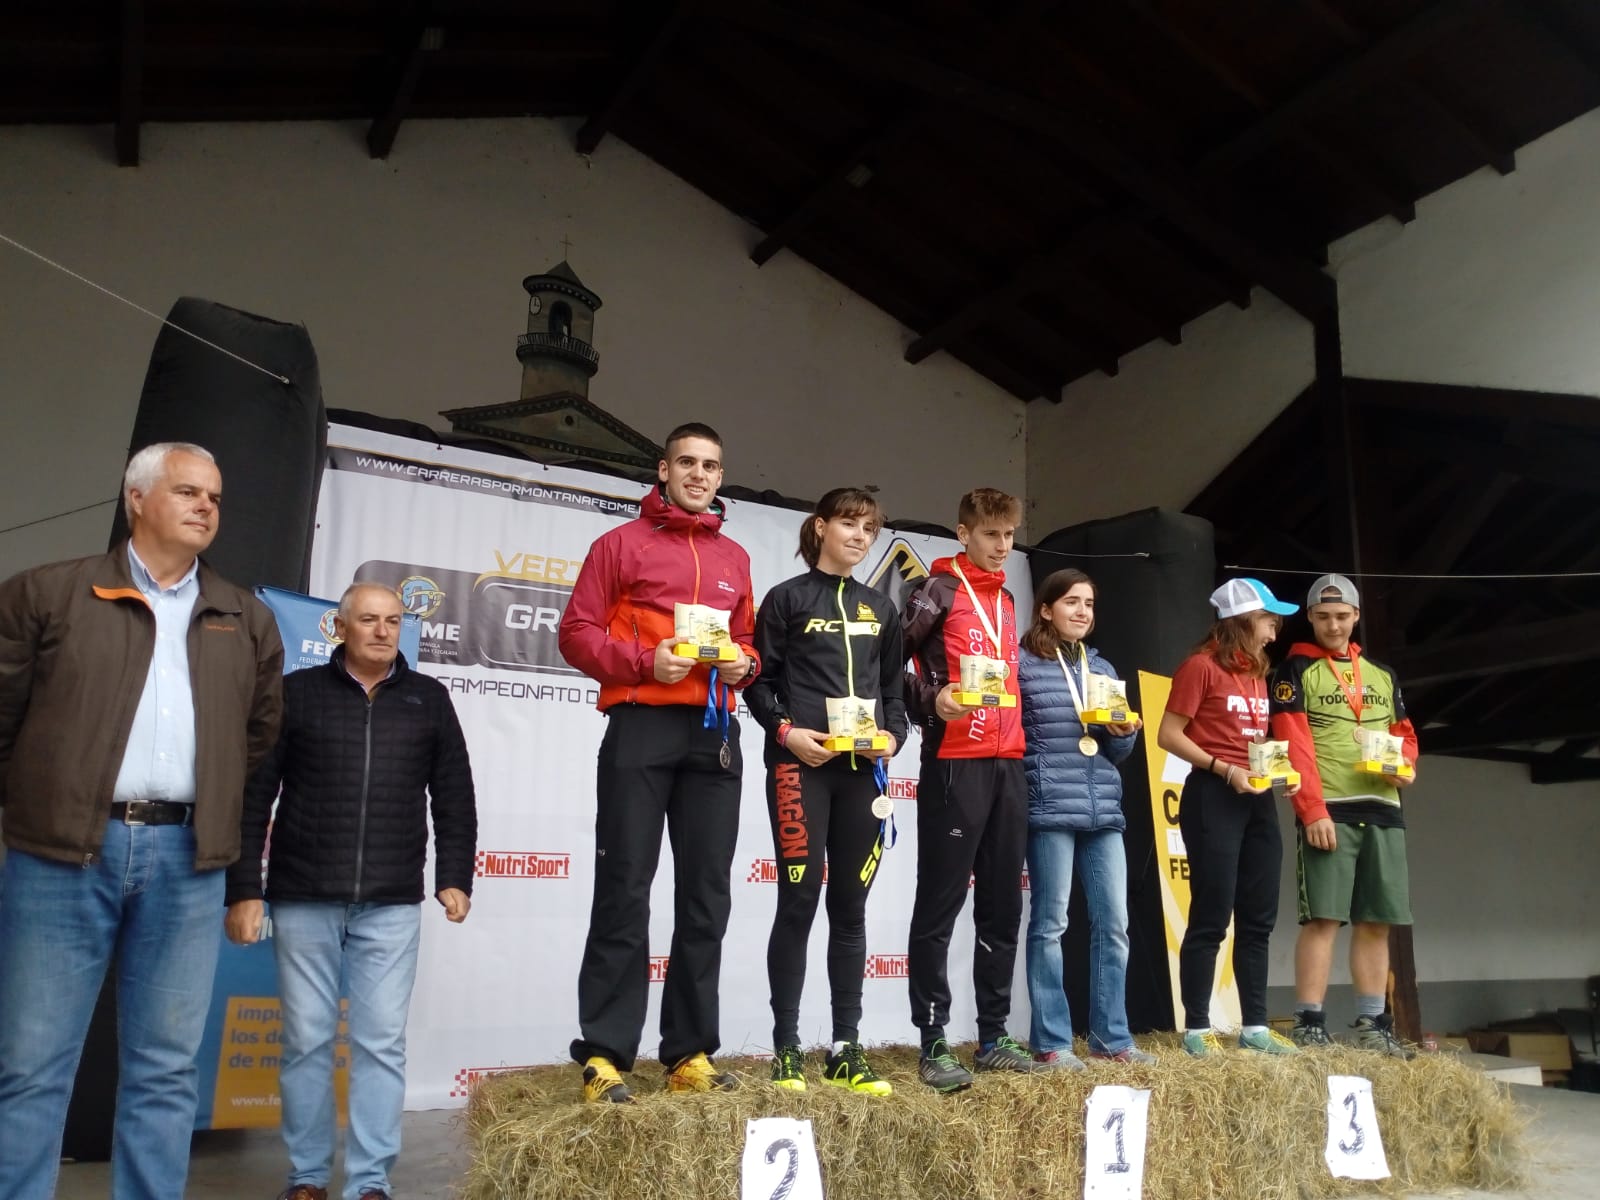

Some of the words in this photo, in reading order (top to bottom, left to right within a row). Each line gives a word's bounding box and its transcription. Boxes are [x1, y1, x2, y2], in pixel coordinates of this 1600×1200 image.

[485, 854, 570, 878] NutriSport
[1102, 1108, 1131, 1174] 1
[1338, 1092, 1365, 1155] 3
[764, 1138, 799, 1200] 2
